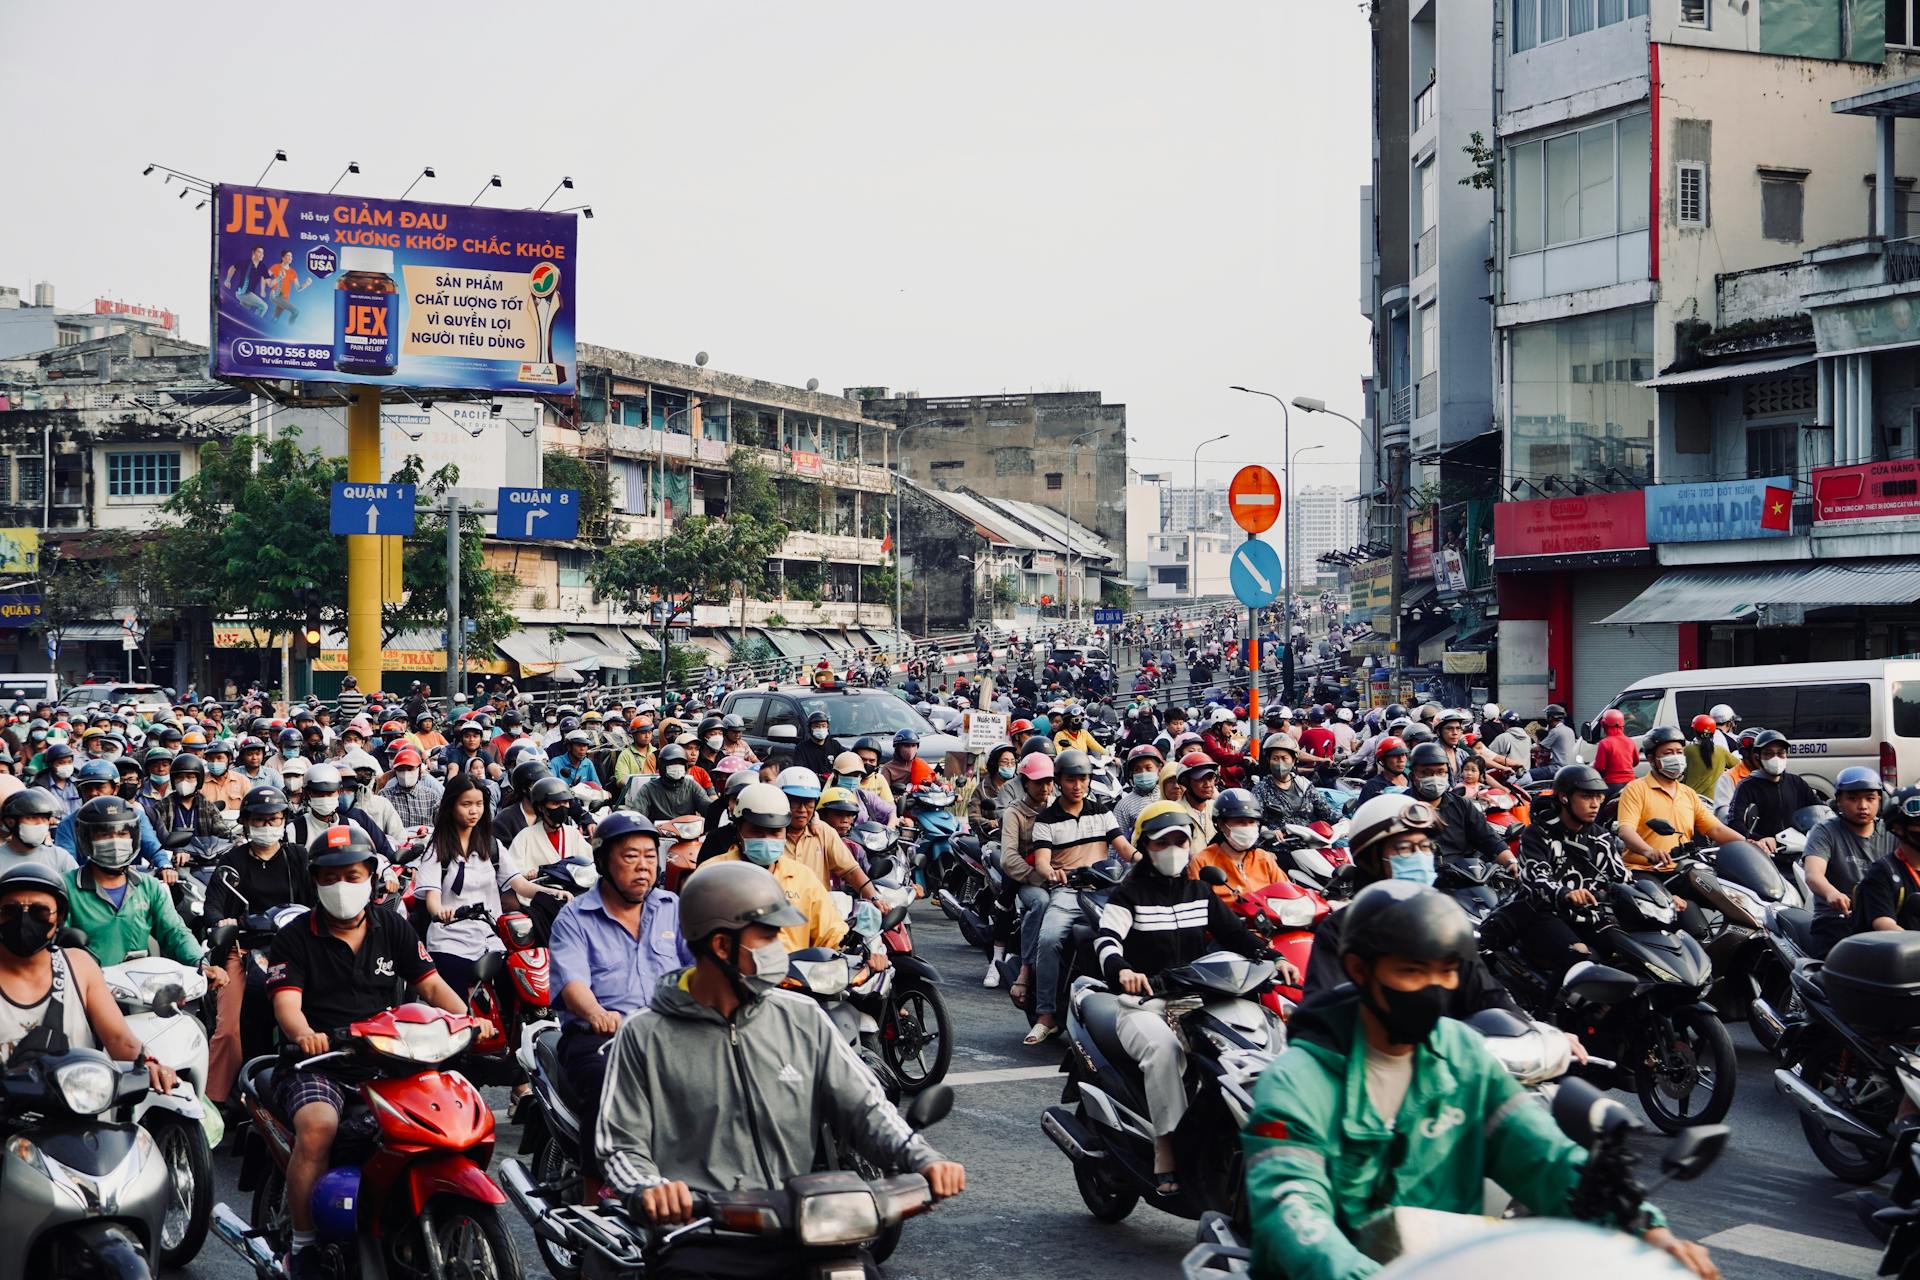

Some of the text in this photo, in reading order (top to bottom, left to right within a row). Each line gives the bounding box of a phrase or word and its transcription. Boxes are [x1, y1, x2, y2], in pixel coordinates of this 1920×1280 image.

[226, 193, 290, 238] JEX
[300, 202, 448, 231] Hỗ trợ GIẢM ĐAU
[300, 228, 566, 260] Bảo vệ XƯƠNG KHỚP CHẮC KHỎE
[309, 259, 334, 272] USA
[435, 272, 504, 292] SẢN PHẨM
[415, 290, 524, 311] CHẤT LƯỢNG TỐT
[344, 304, 388, 337] JEX
[426, 311, 511, 333] VÌ QUYỀN LỢI
[350, 344, 384, 353] PAIN RELIEF
[368, 338, 389, 346] JOINT
[411, 330, 526, 350] NGƯỜI TIÊU DÙNG
[254, 344, 331, 361] 1800 556 889
[271, 358, 283, 366] vấn
[283, 358, 301, 367] miễn
[301, 359, 317, 368] cước
[453, 409, 487, 420] PACIF
[343, 487, 404, 502] QUẬN 1
[509, 490, 569, 507] QUẬN 8
[1730, 494, 1761, 526] DIỆ
[1, 603, 41, 617] QUẬN 5
[1788, 743, 1827, 754] 1B-260.70
[374, 956, 396, 977] Lee
